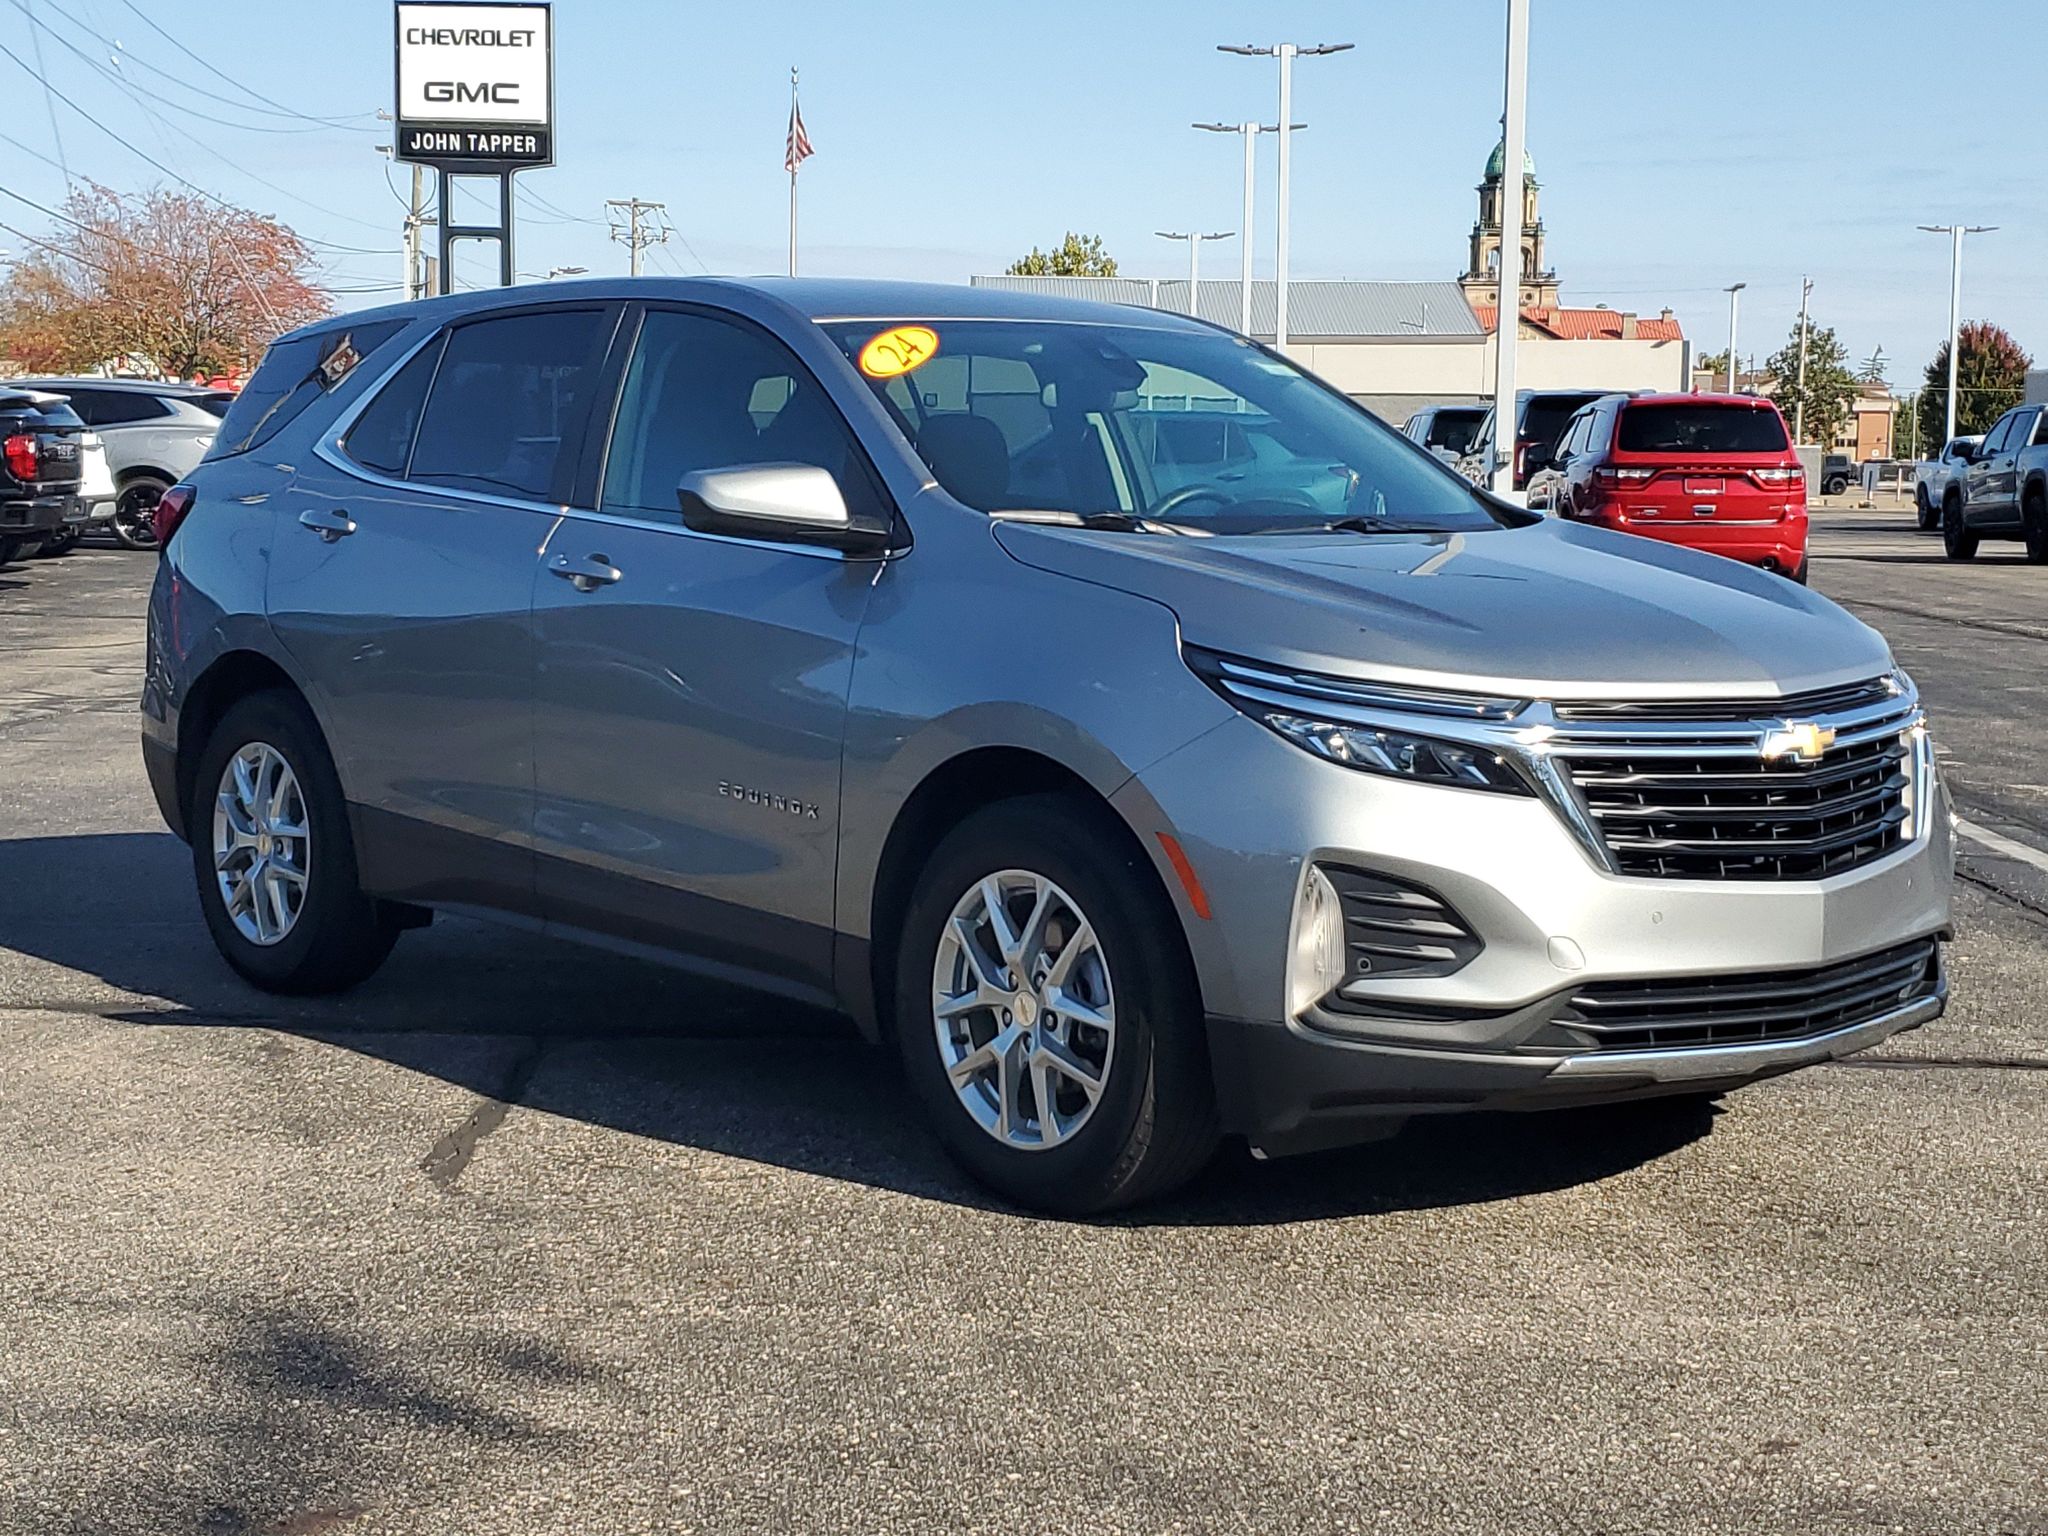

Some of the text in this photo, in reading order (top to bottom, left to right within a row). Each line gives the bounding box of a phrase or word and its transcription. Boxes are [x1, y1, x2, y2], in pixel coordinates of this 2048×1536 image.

[406, 28, 536, 47] CHEVROLET
[424, 81, 520, 104] GMC
[410, 132, 537, 153] JOHN TAPPER
[876, 333, 924, 368] 24
[718, 780, 820, 820] EQUINOX
